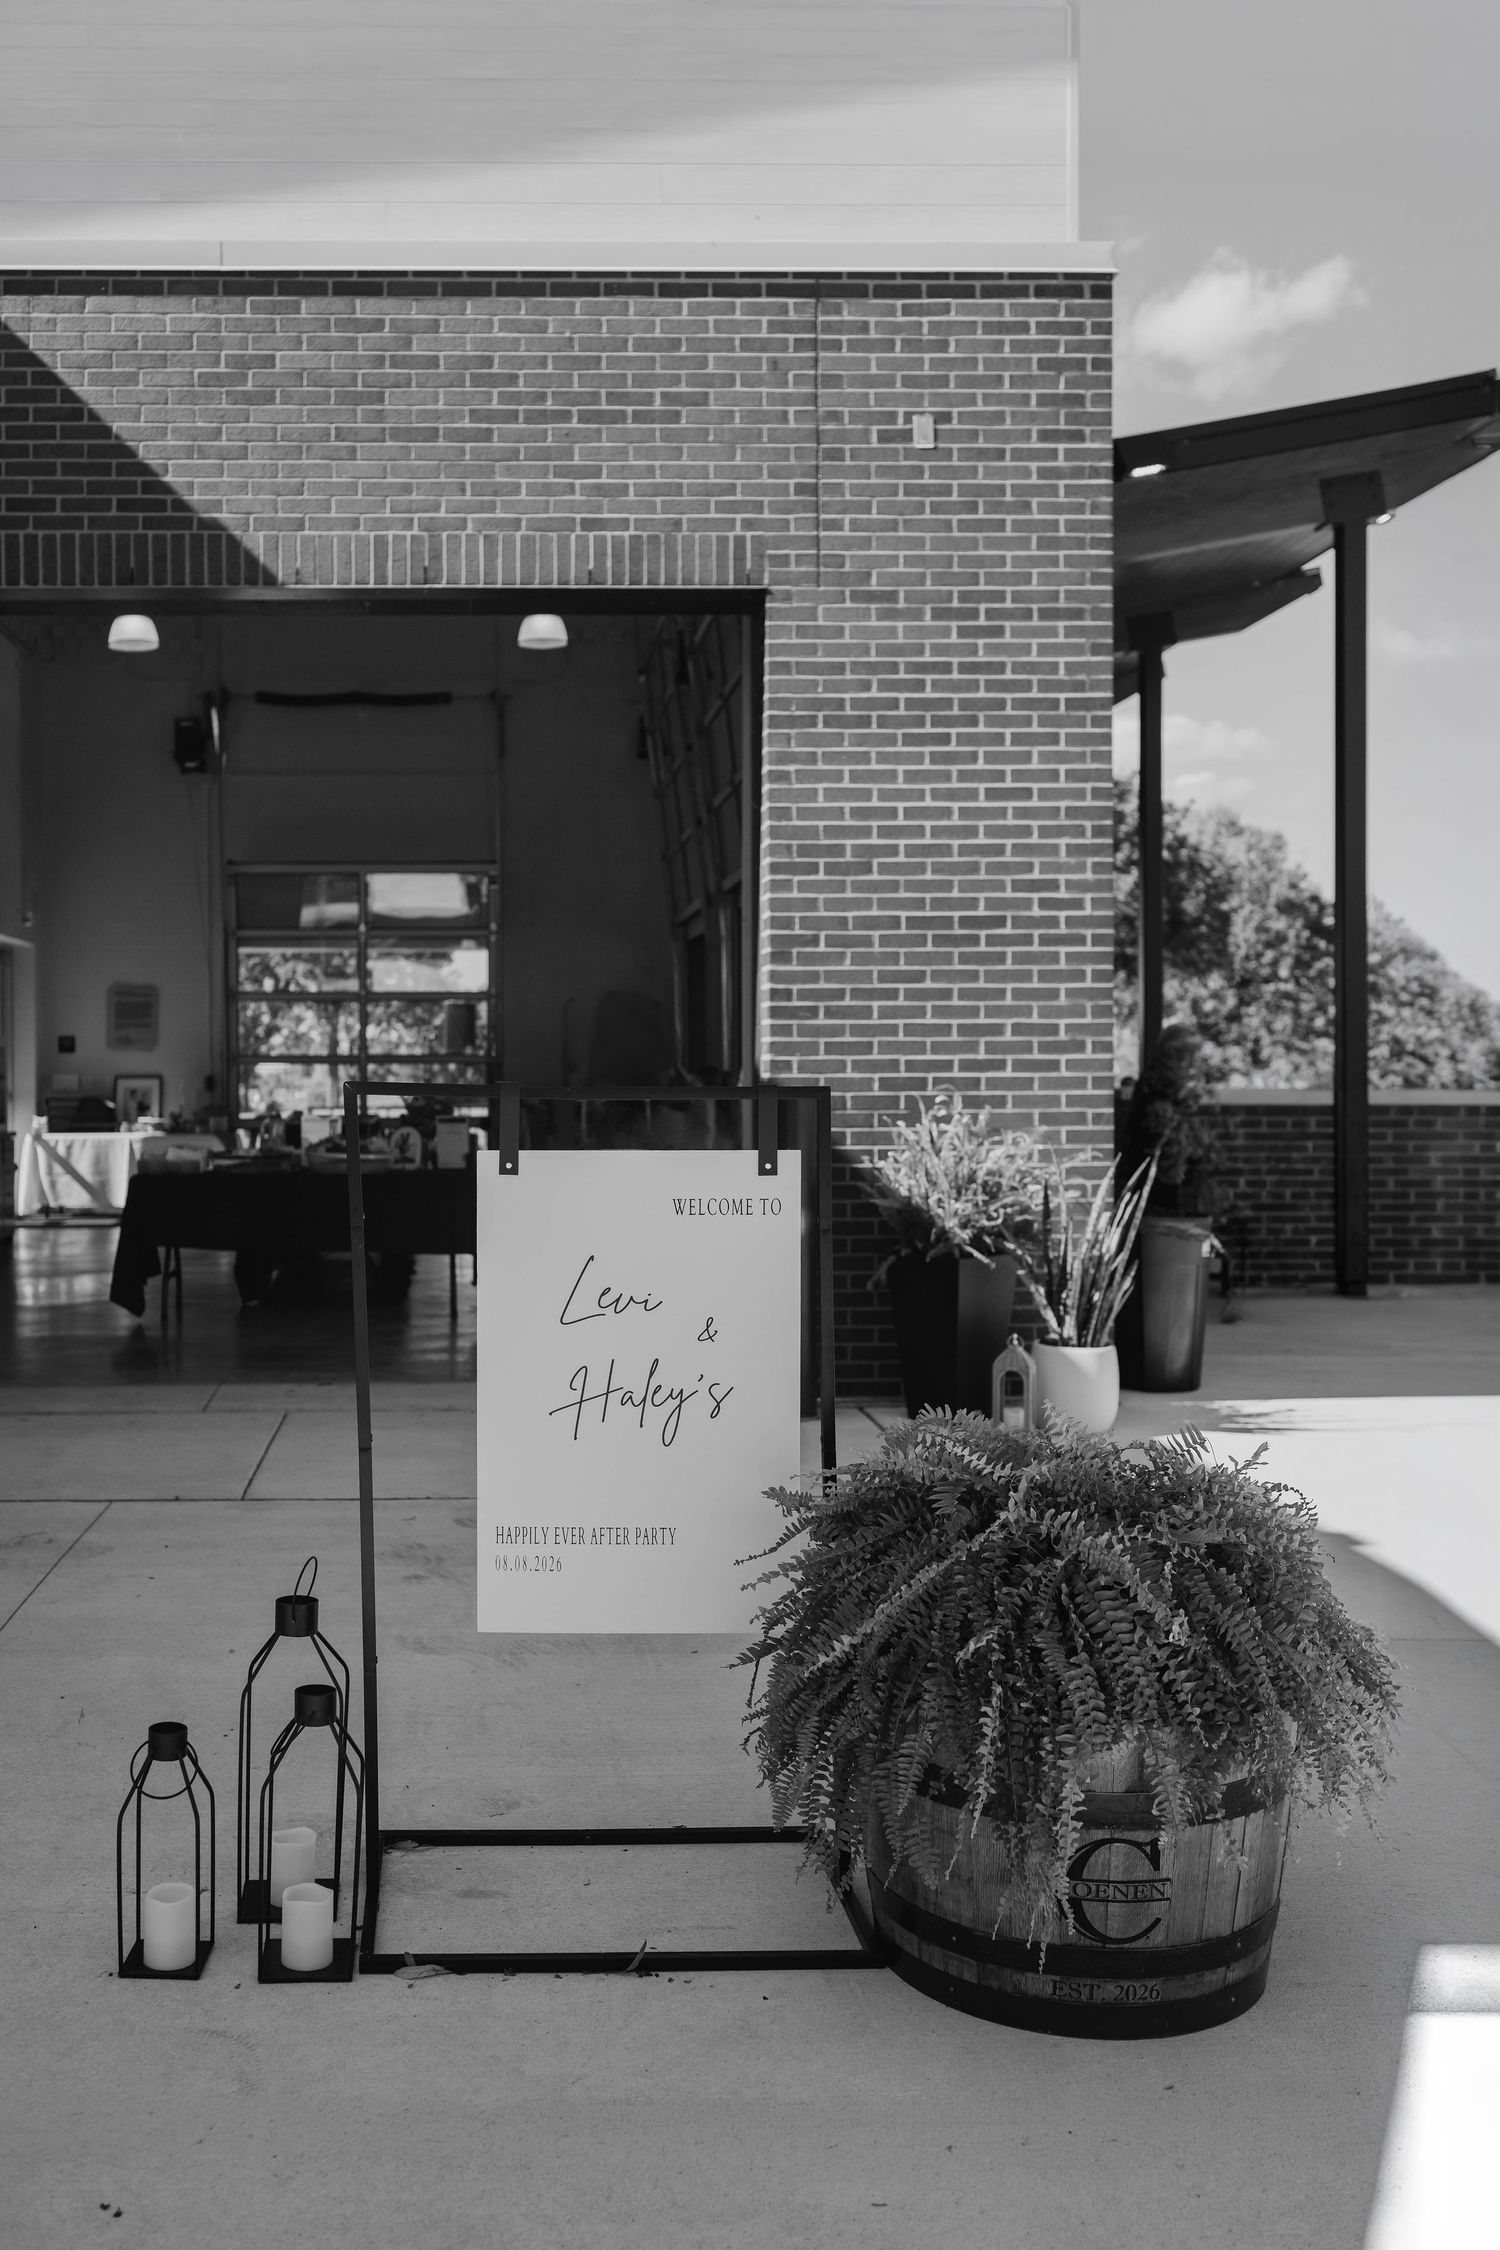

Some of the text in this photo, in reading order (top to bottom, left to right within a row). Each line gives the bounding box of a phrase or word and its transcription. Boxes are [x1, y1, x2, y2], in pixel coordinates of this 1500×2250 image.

[671, 1197, 782, 1216] WELCOME TO
[560, 1254, 663, 1325] Levi
[697, 1316, 719, 1343] &
[548, 1357, 735, 1447] Haley's
[495, 1525, 677, 1546] HAPPILY EVER AFTER PARTY
[494, 1554, 562, 1573] 08.08.2026
[1054, 1881, 1168, 1900] OENEN
[1054, 1837, 1163, 1945] C
[1050, 1979, 1161, 2001] EST. 2026
